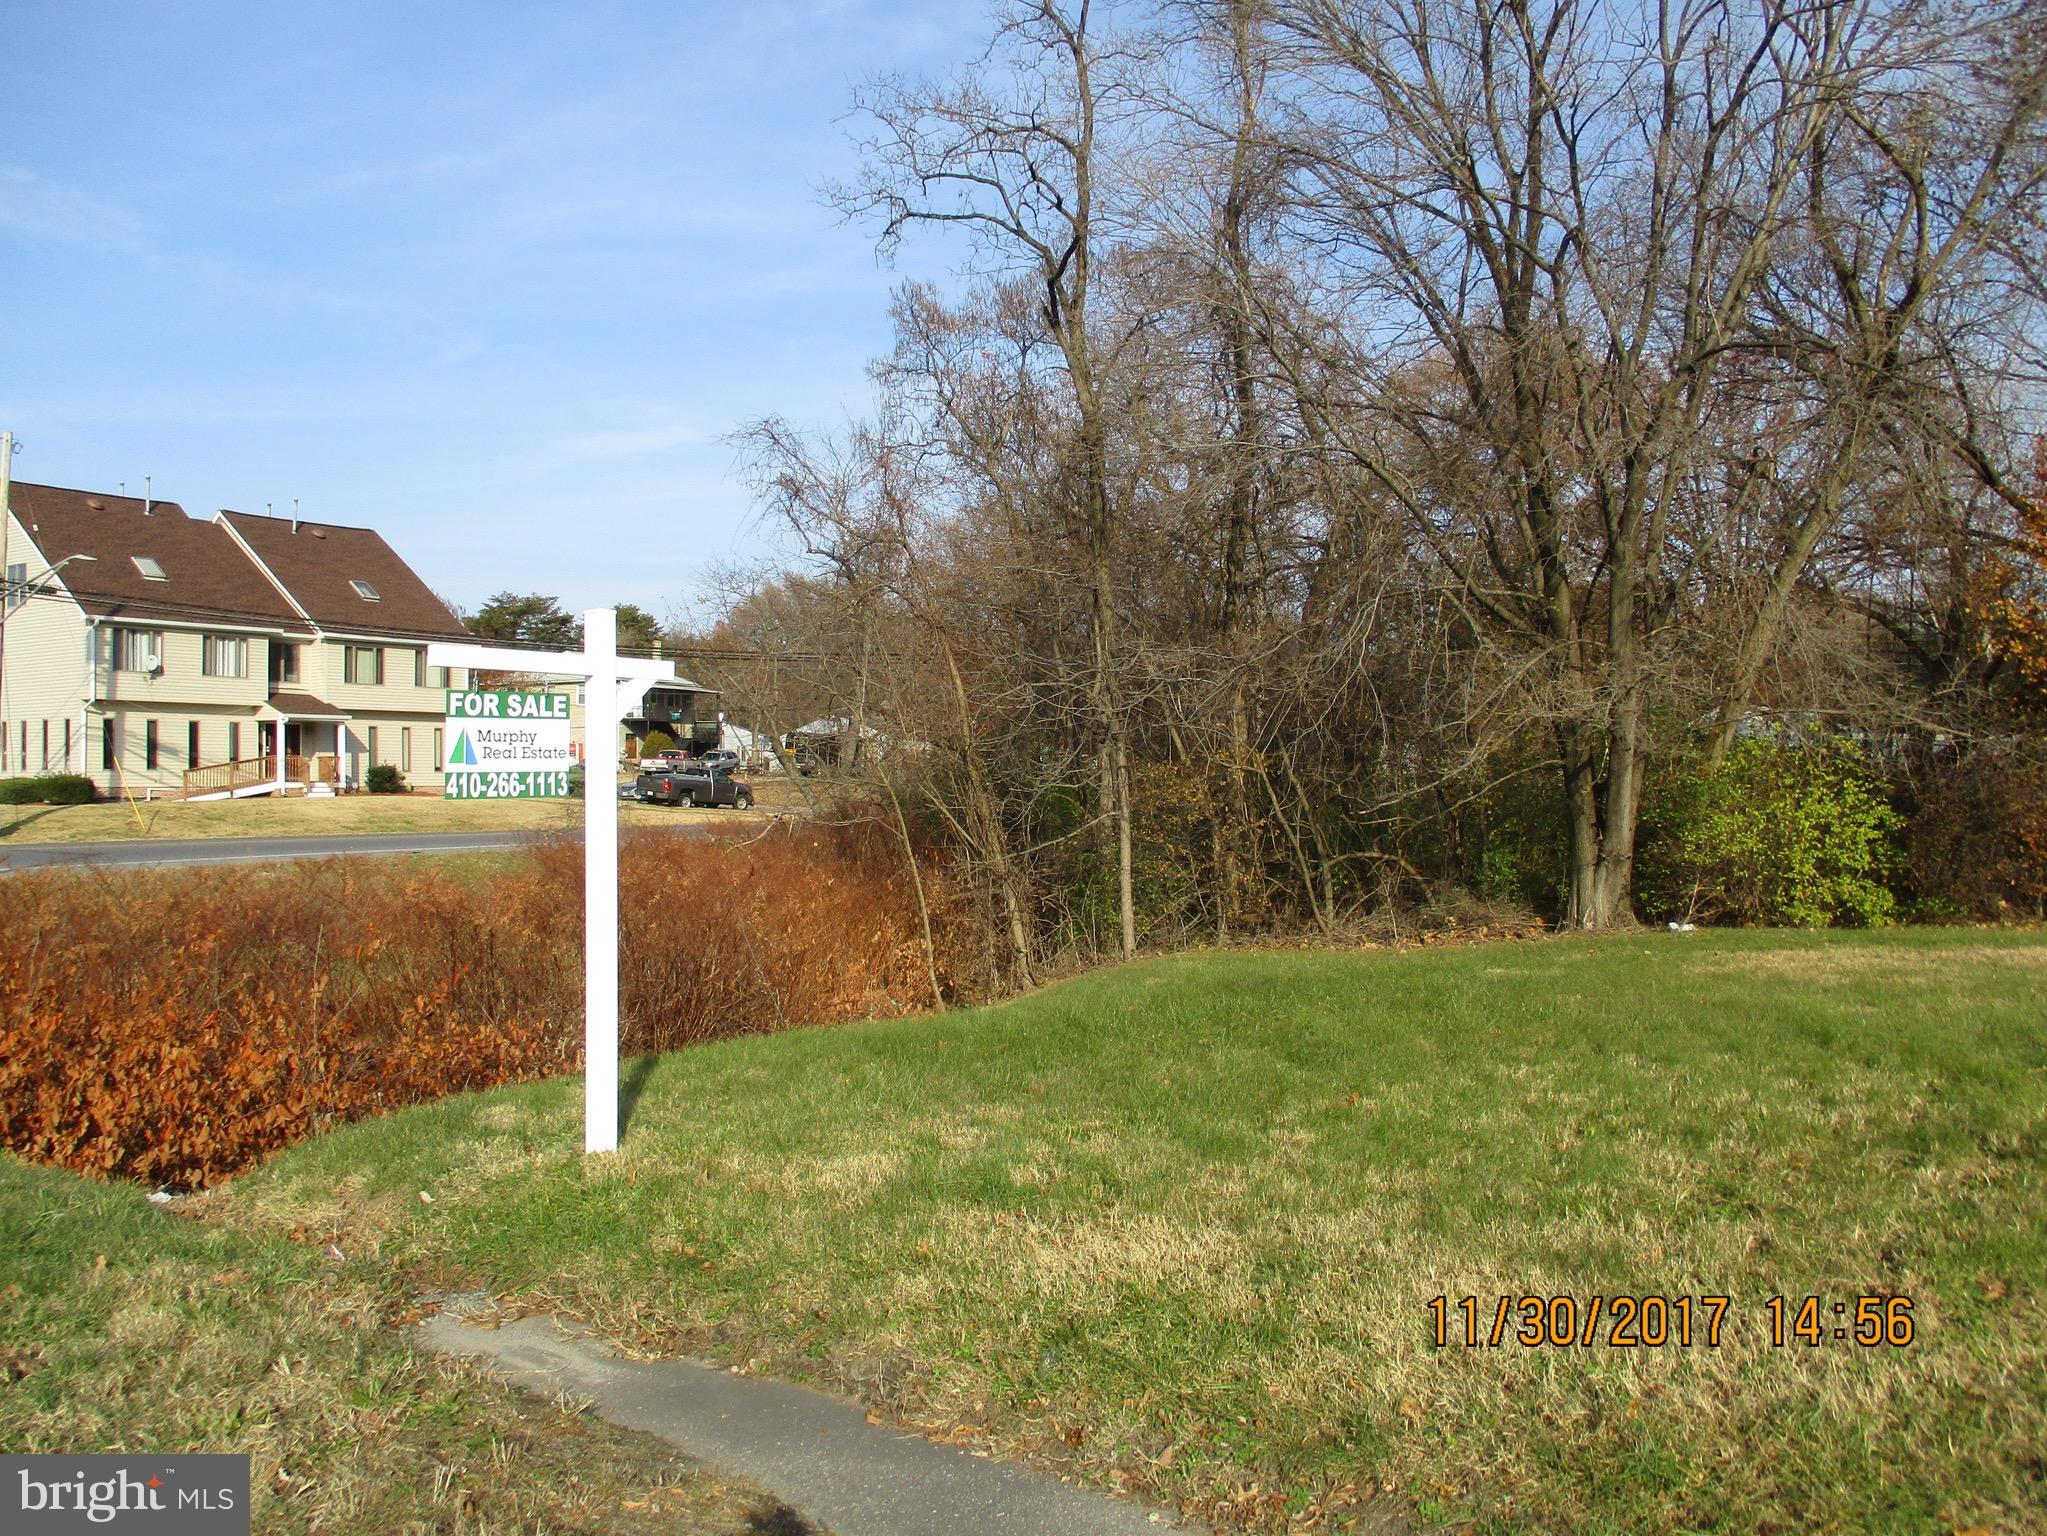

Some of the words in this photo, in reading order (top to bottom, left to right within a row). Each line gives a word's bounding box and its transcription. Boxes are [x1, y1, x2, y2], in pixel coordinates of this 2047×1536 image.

[449, 692, 500, 717] FOR
[507, 694, 567, 718] SALE
[477, 729, 537, 746] Murphy
[482, 746, 517, 759] Real
[522, 746, 567, 760] Estate
[446, 772, 568, 798] 410-266-1113
